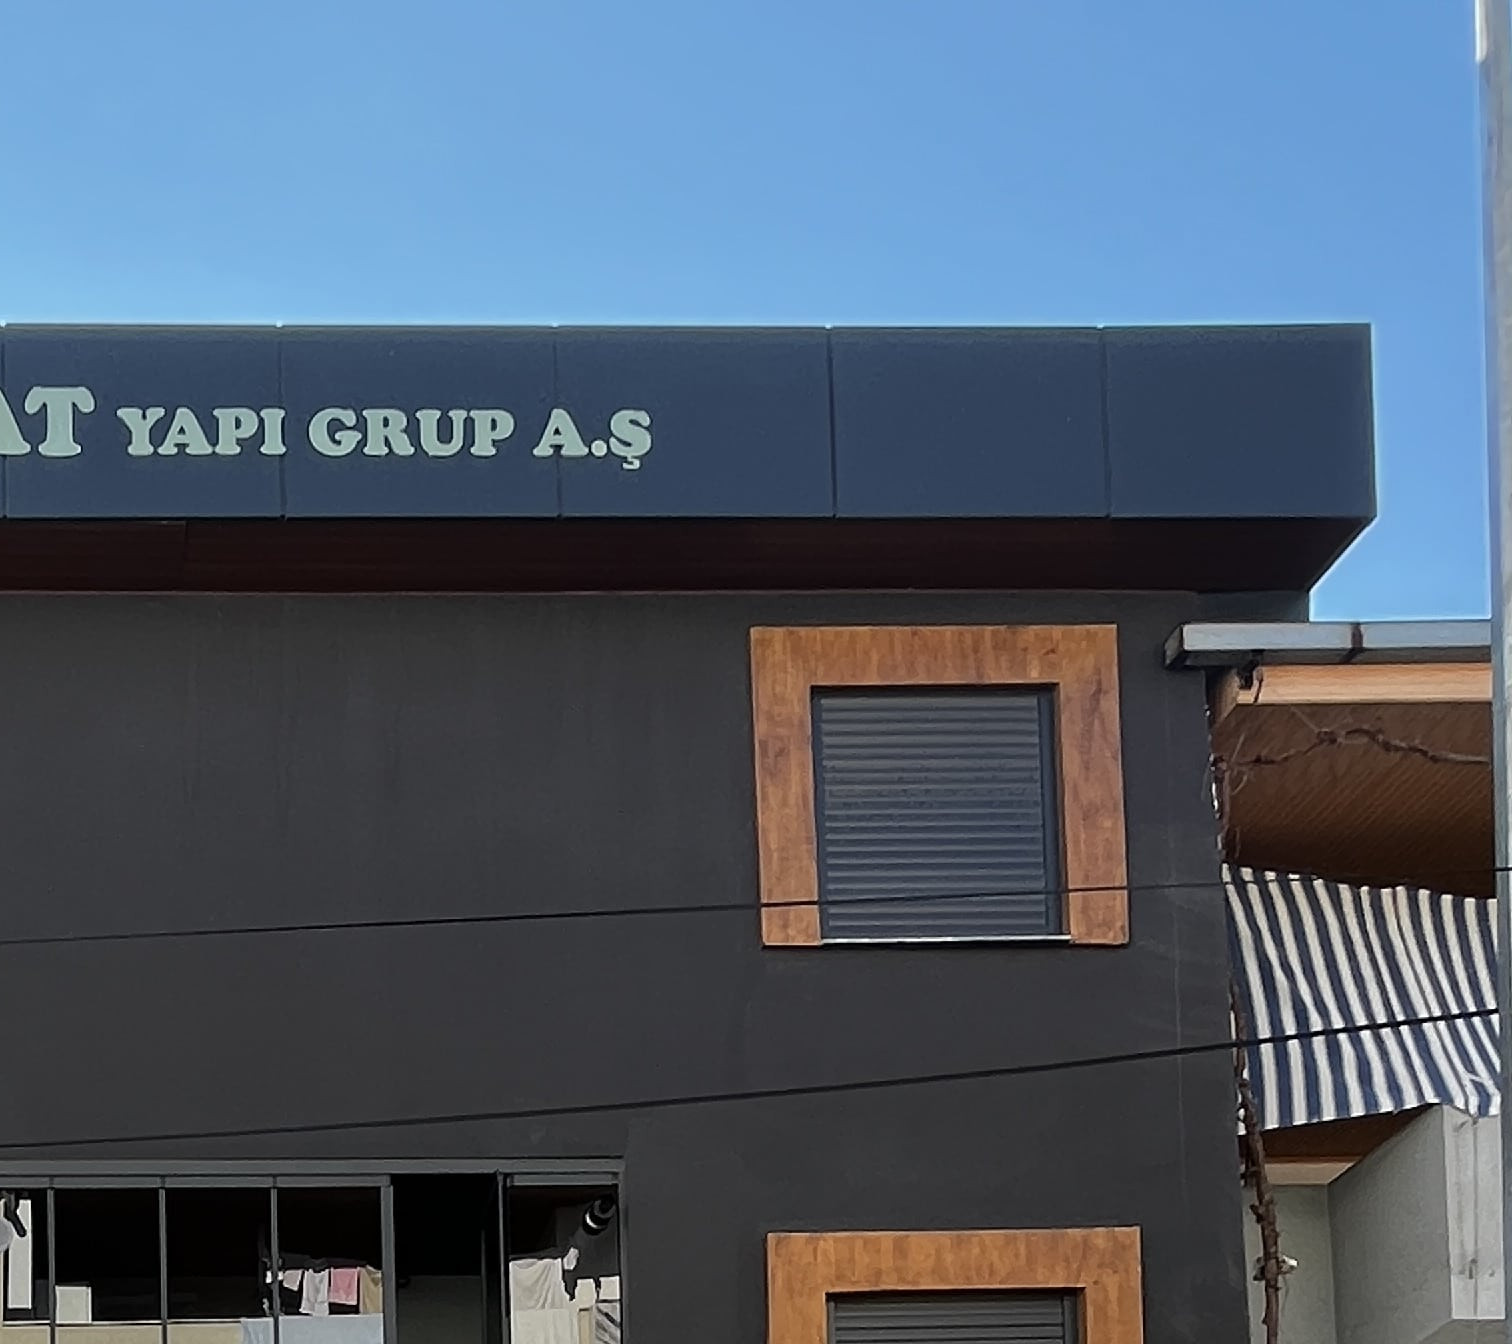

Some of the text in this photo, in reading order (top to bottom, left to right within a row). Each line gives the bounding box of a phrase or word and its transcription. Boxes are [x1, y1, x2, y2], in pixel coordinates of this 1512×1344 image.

[116, 406, 287, 457] YAPI
[308, 406, 516, 457] GRUP
[532, 407, 653, 469] A.Ş
